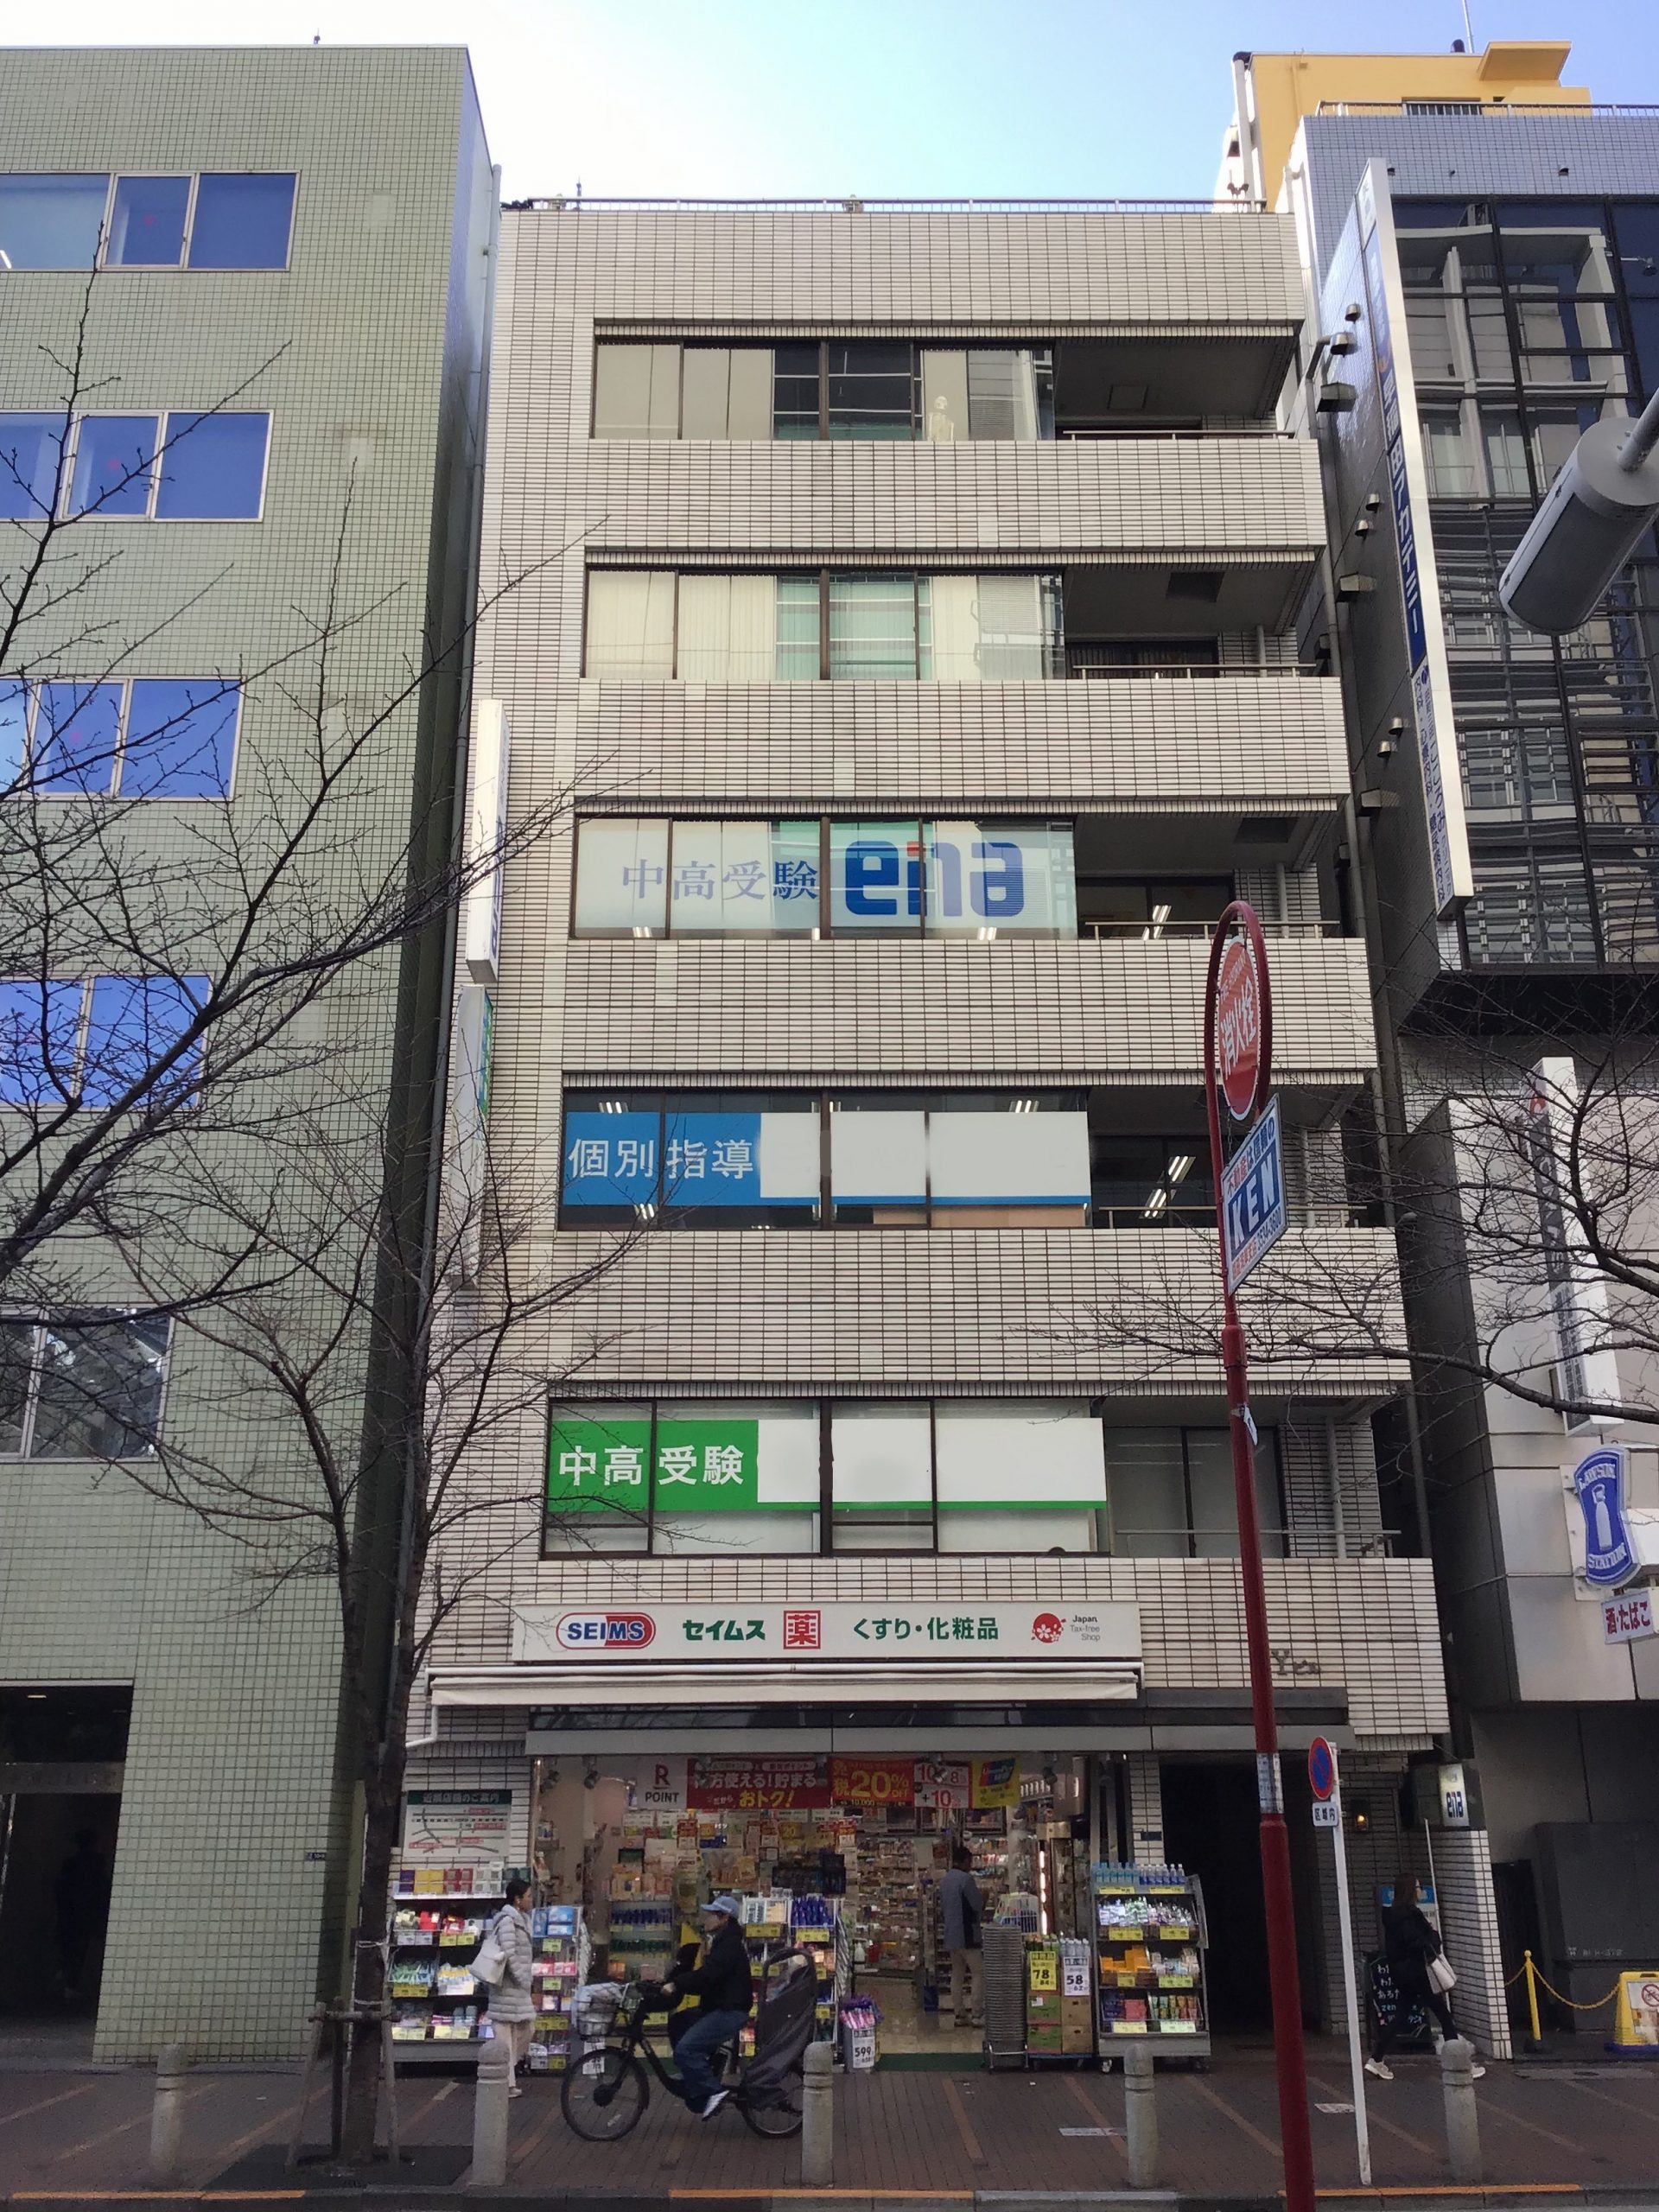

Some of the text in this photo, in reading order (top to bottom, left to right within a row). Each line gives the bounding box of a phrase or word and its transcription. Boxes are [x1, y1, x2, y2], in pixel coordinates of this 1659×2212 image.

[1382, 370, 1419, 634] 早稲田アカデミー
[622, 858, 819, 901] 中高受験
[844, 840, 1025, 918] ena
[1220, 976, 1256, 1080] 消火栓
[568, 1137, 754, 1180] 個別指導
[1232, 1153, 1274, 1250] KEN
[558, 1444, 746, 1487] 中高受験
[1578, 1462, 1617, 1491] LAWSON
[1587, 1542, 1627, 1569] STATION
[786, 1614, 817, 1646] 薬
[853, 1617, 1000, 1641] くすり・化粧品
[1070, 1624, 1100, 1633] Tax-free
[1072, 1615, 1098, 1624] Japan
[1605, 1599, 1651, 1636] 酒・たばこ
[567, 1621, 645, 1641] SEIMS
[683, 1619, 766, 1642] セイムス
[1081, 1633, 1101, 1643] Shop
[654, 1764, 671, 1789] R
[645, 1791, 679, 1803] POINT
[739, 1789, 795, 1808] おトク!
[1033, 1968, 1050, 1980] 78
[1066, 1974, 1084, 1986] 58
[855, 2046, 872, 2058] 599
